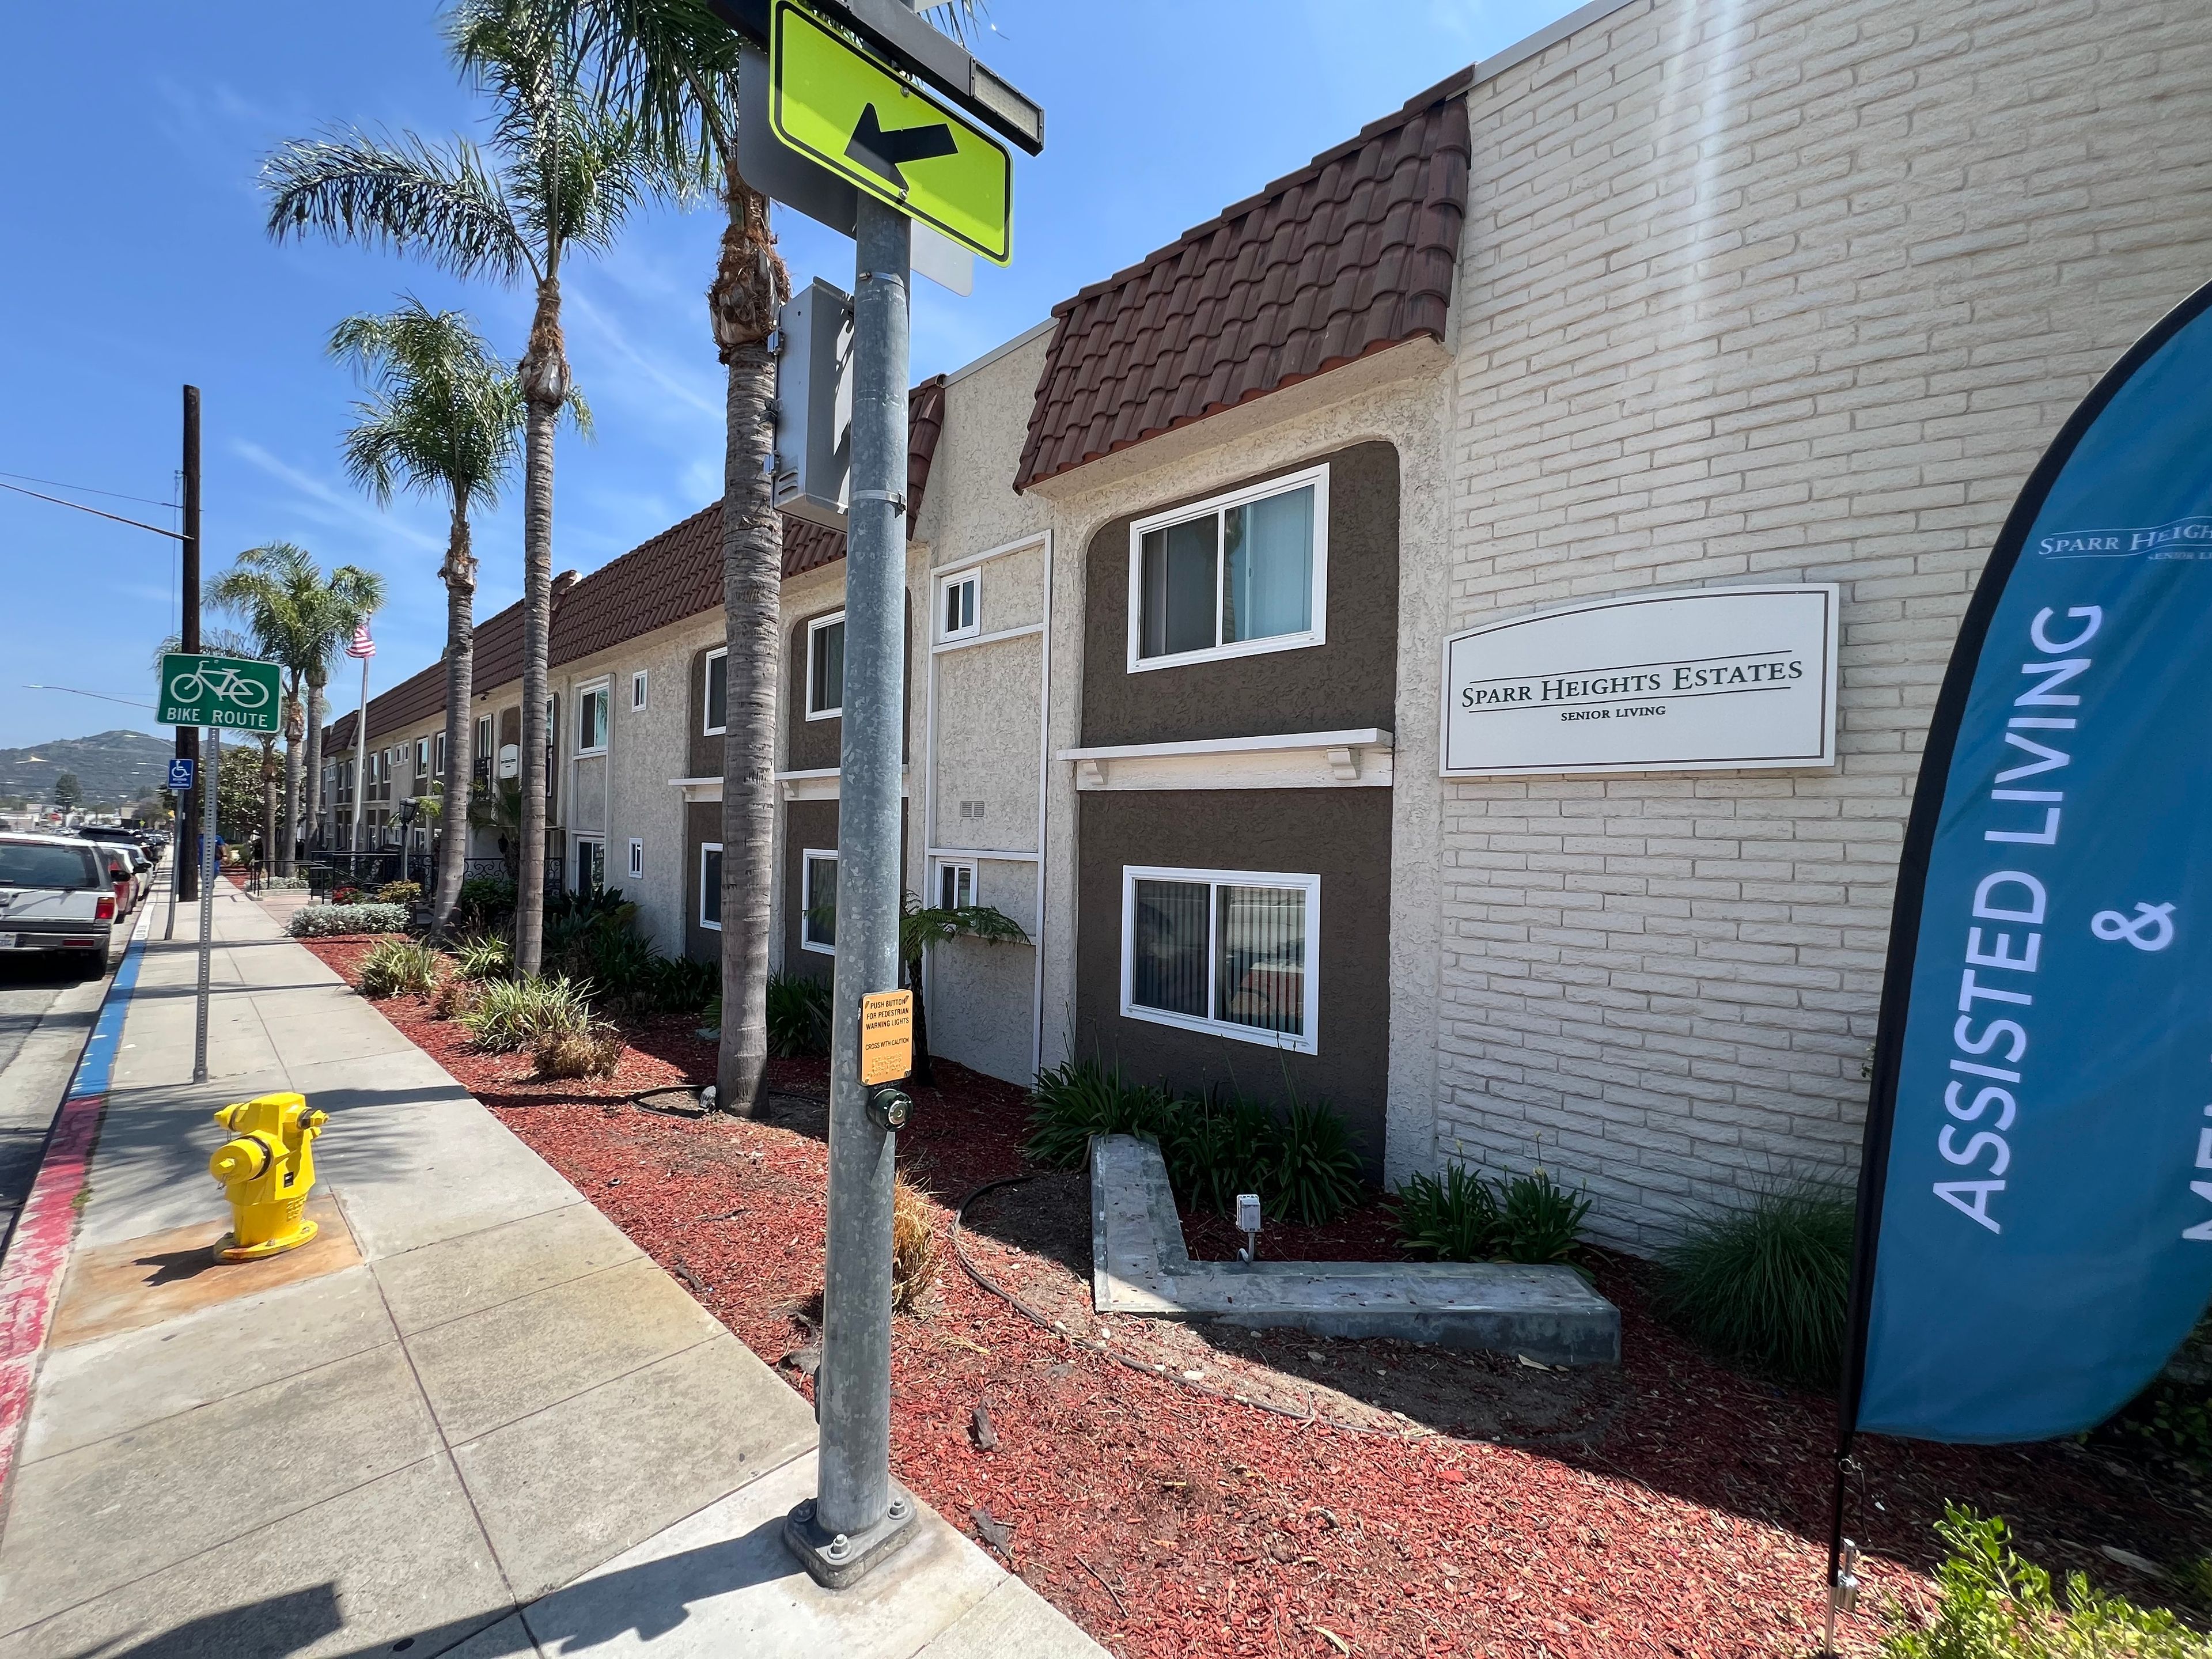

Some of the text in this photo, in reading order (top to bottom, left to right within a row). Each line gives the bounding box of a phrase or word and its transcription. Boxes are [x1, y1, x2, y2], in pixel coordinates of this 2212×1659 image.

[1461, 660, 1803, 708] SPARR HEIGHTS ESTATES
[166, 707, 268, 728] BIKE ROUTE
[1560, 706, 1666, 721] SENIOR LIVING
[1932, 605, 2102, 1234] ASSISTED LIVING
[2090, 902, 2177, 952] &
[870, 998, 906, 1009] PUSH BUTTON
[878, 1007, 909, 1018] PEDESTRIAN
[866, 1017, 909, 1030] WARNING LIGHTS
[865, 1042, 880, 1051] CROSS
[891, 1037, 910, 1046] CAUTION
